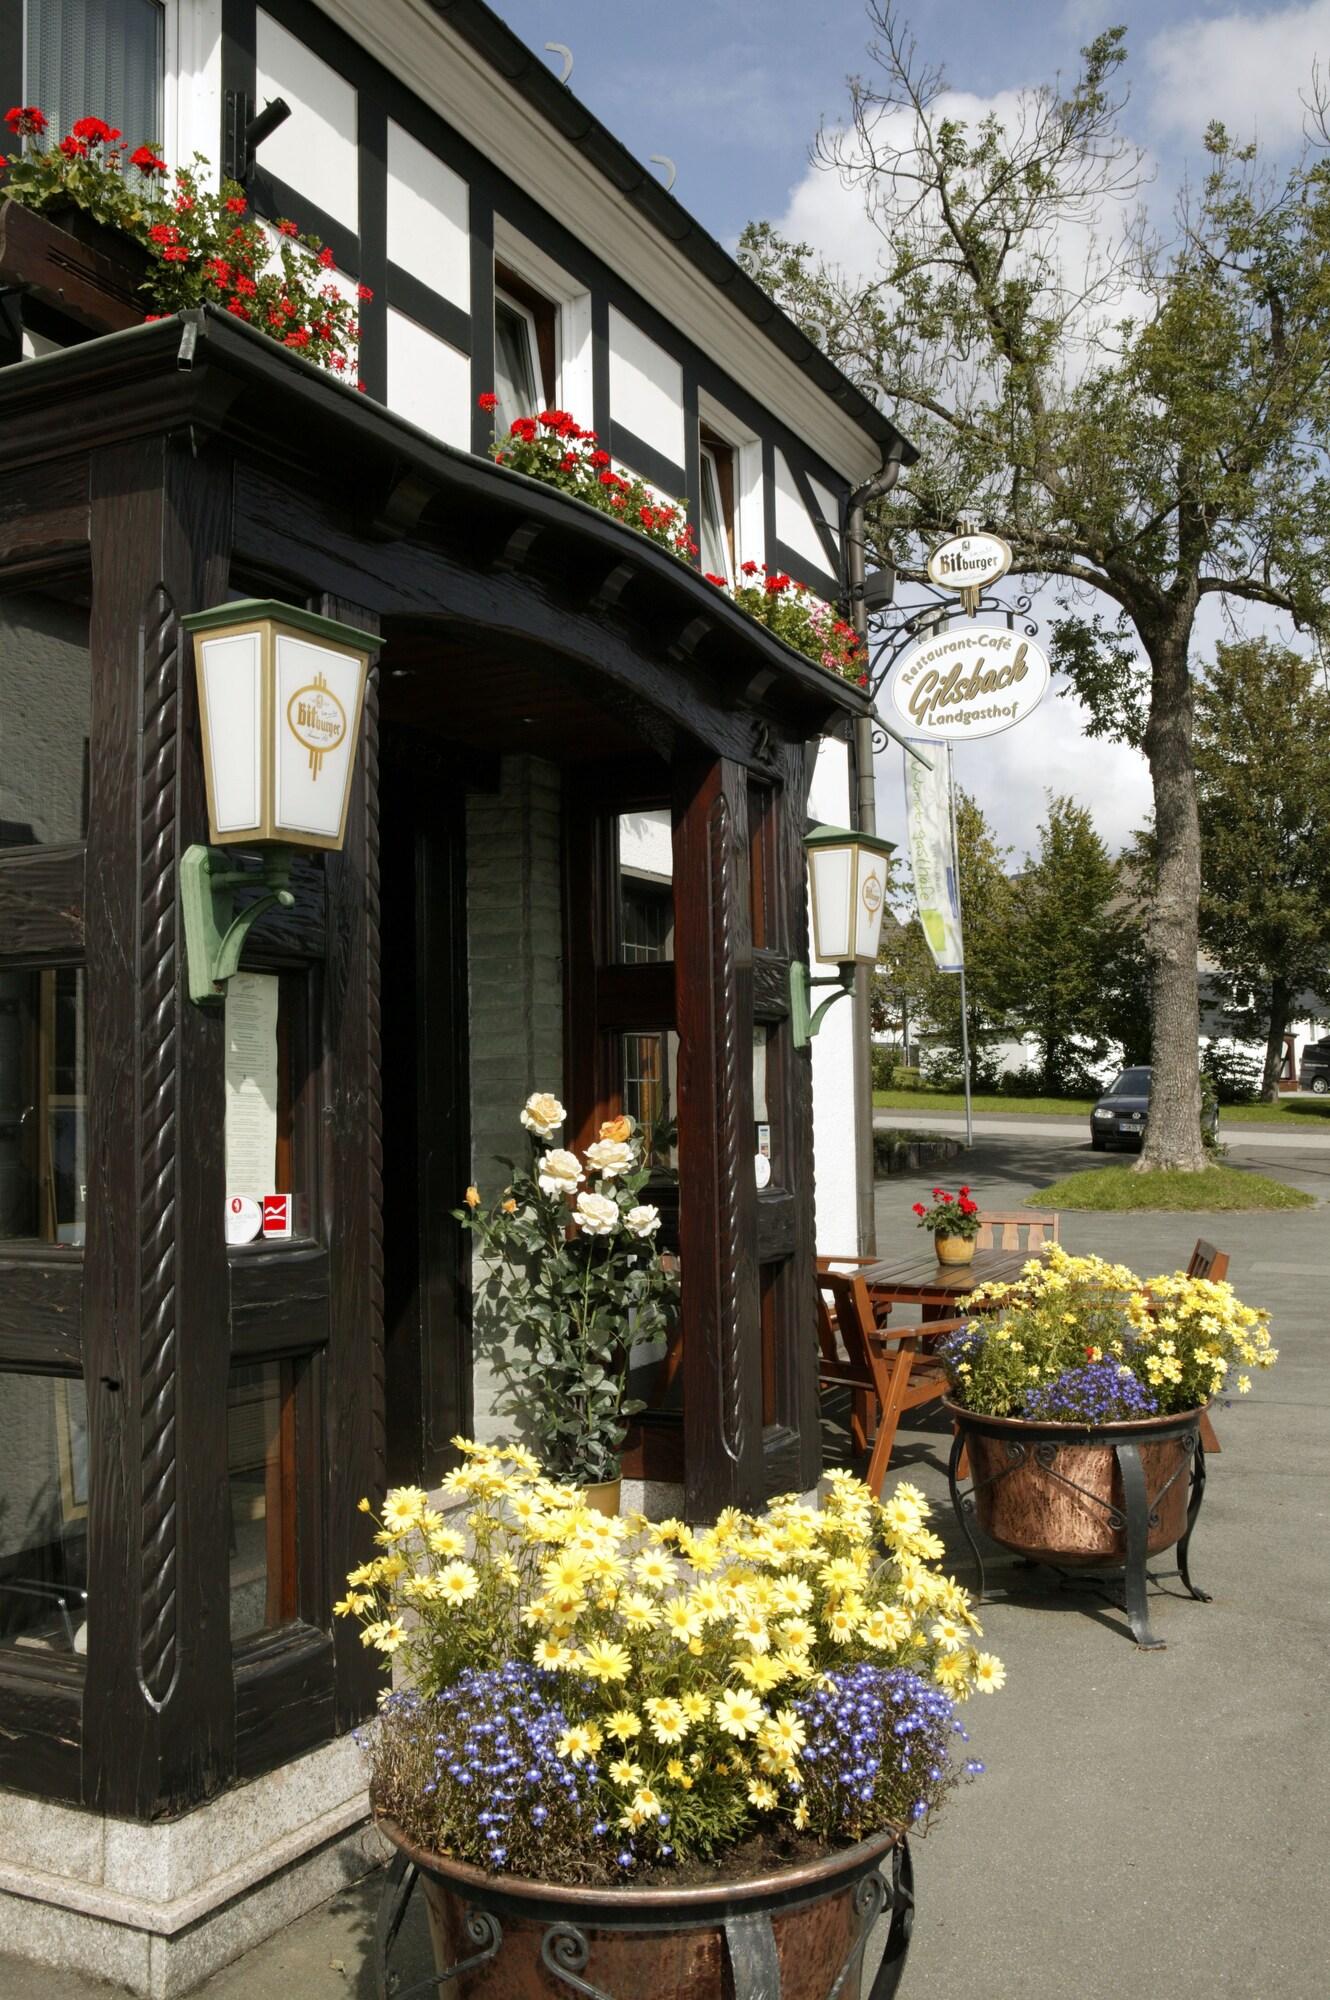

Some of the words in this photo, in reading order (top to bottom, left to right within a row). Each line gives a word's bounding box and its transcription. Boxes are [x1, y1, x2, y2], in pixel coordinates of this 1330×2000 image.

[940, 552, 998, 575] Bitburger
[902, 634, 1012, 685] Restaurant-Café
[908, 642, 1029, 726] Gilsbach
[297, 702, 341, 737] Bitburger
[928, 701, 1019, 726] Landgasthof
